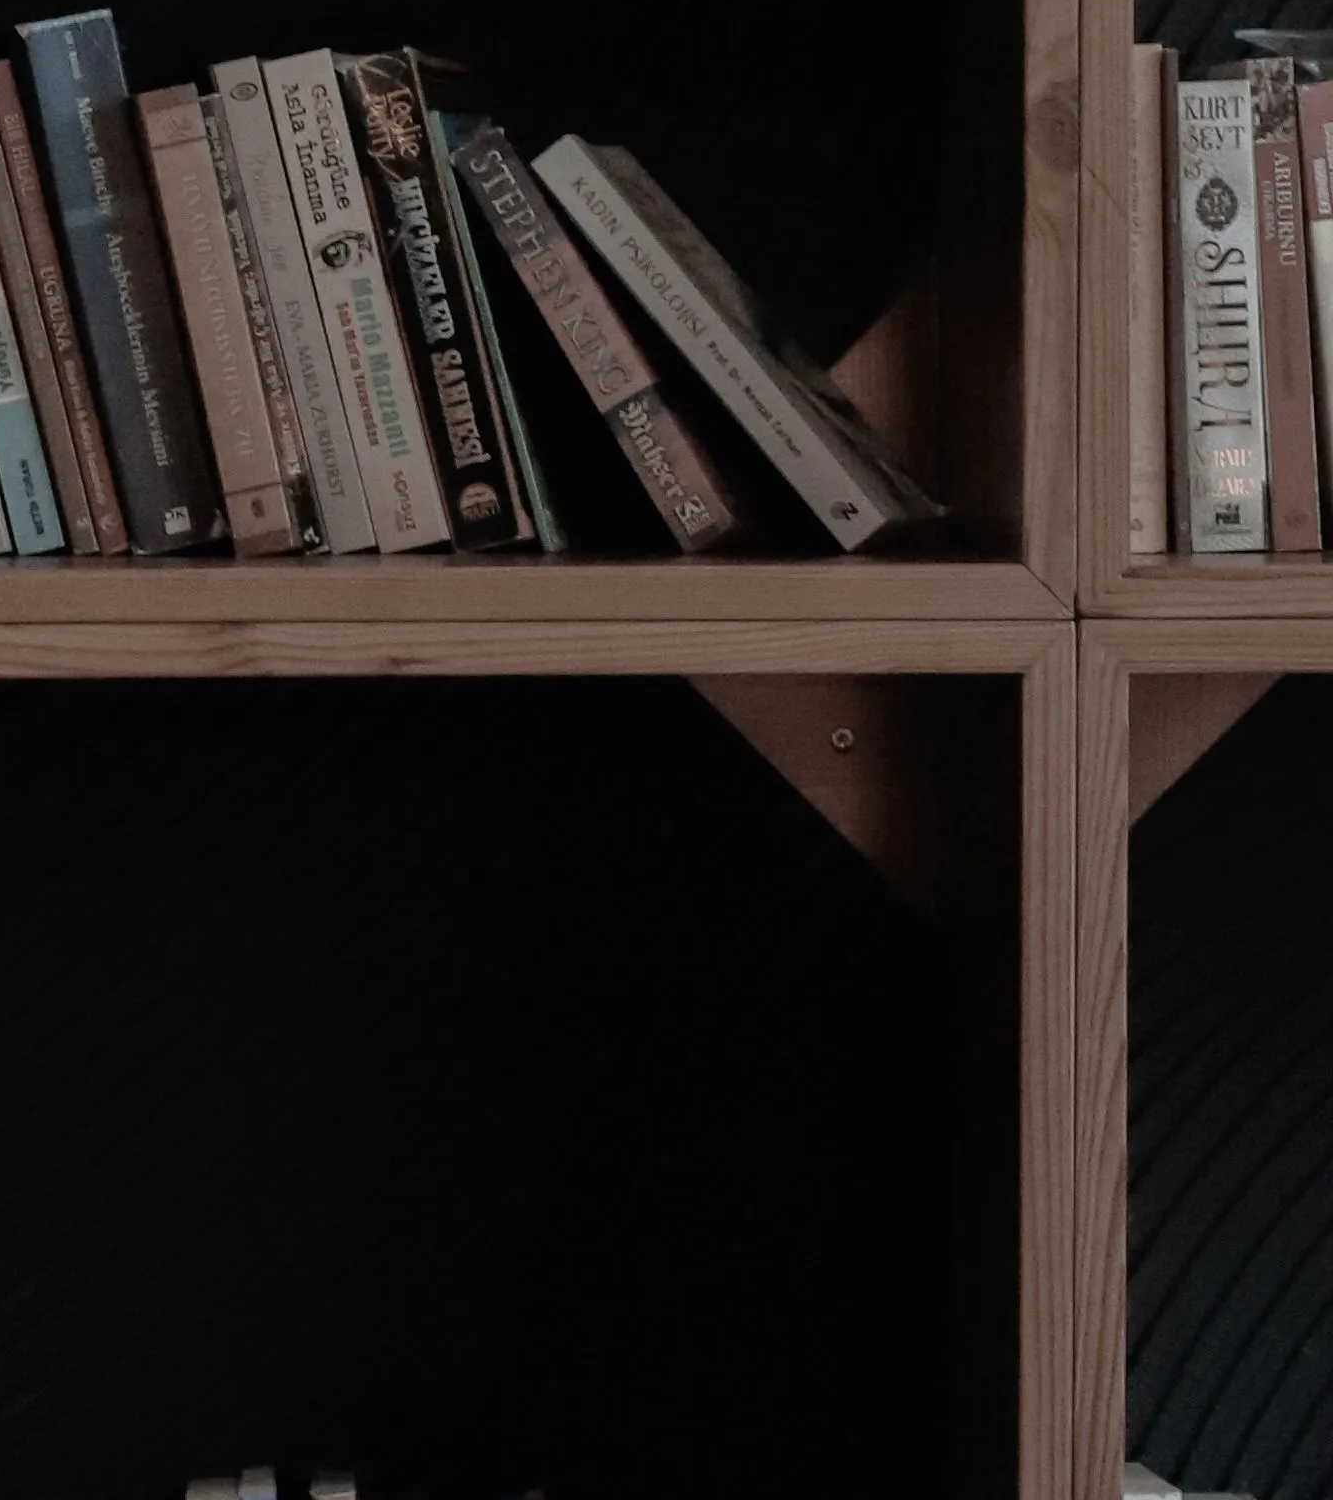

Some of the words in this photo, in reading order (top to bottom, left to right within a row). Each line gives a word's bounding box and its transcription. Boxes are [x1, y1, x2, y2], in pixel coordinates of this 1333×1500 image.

[75, 95, 103, 157] Maeve
[283, 82, 307, 135] Asla
[309, 82, 352, 212] Gördüğüne
[570, 176, 619, 235] KADIN
[470, 148, 573, 311] STEPHEN
[565, 311, 630, 396] KING
[350, 277, 384, 346] Mario
[368, 350, 412, 460] Mazzanti
